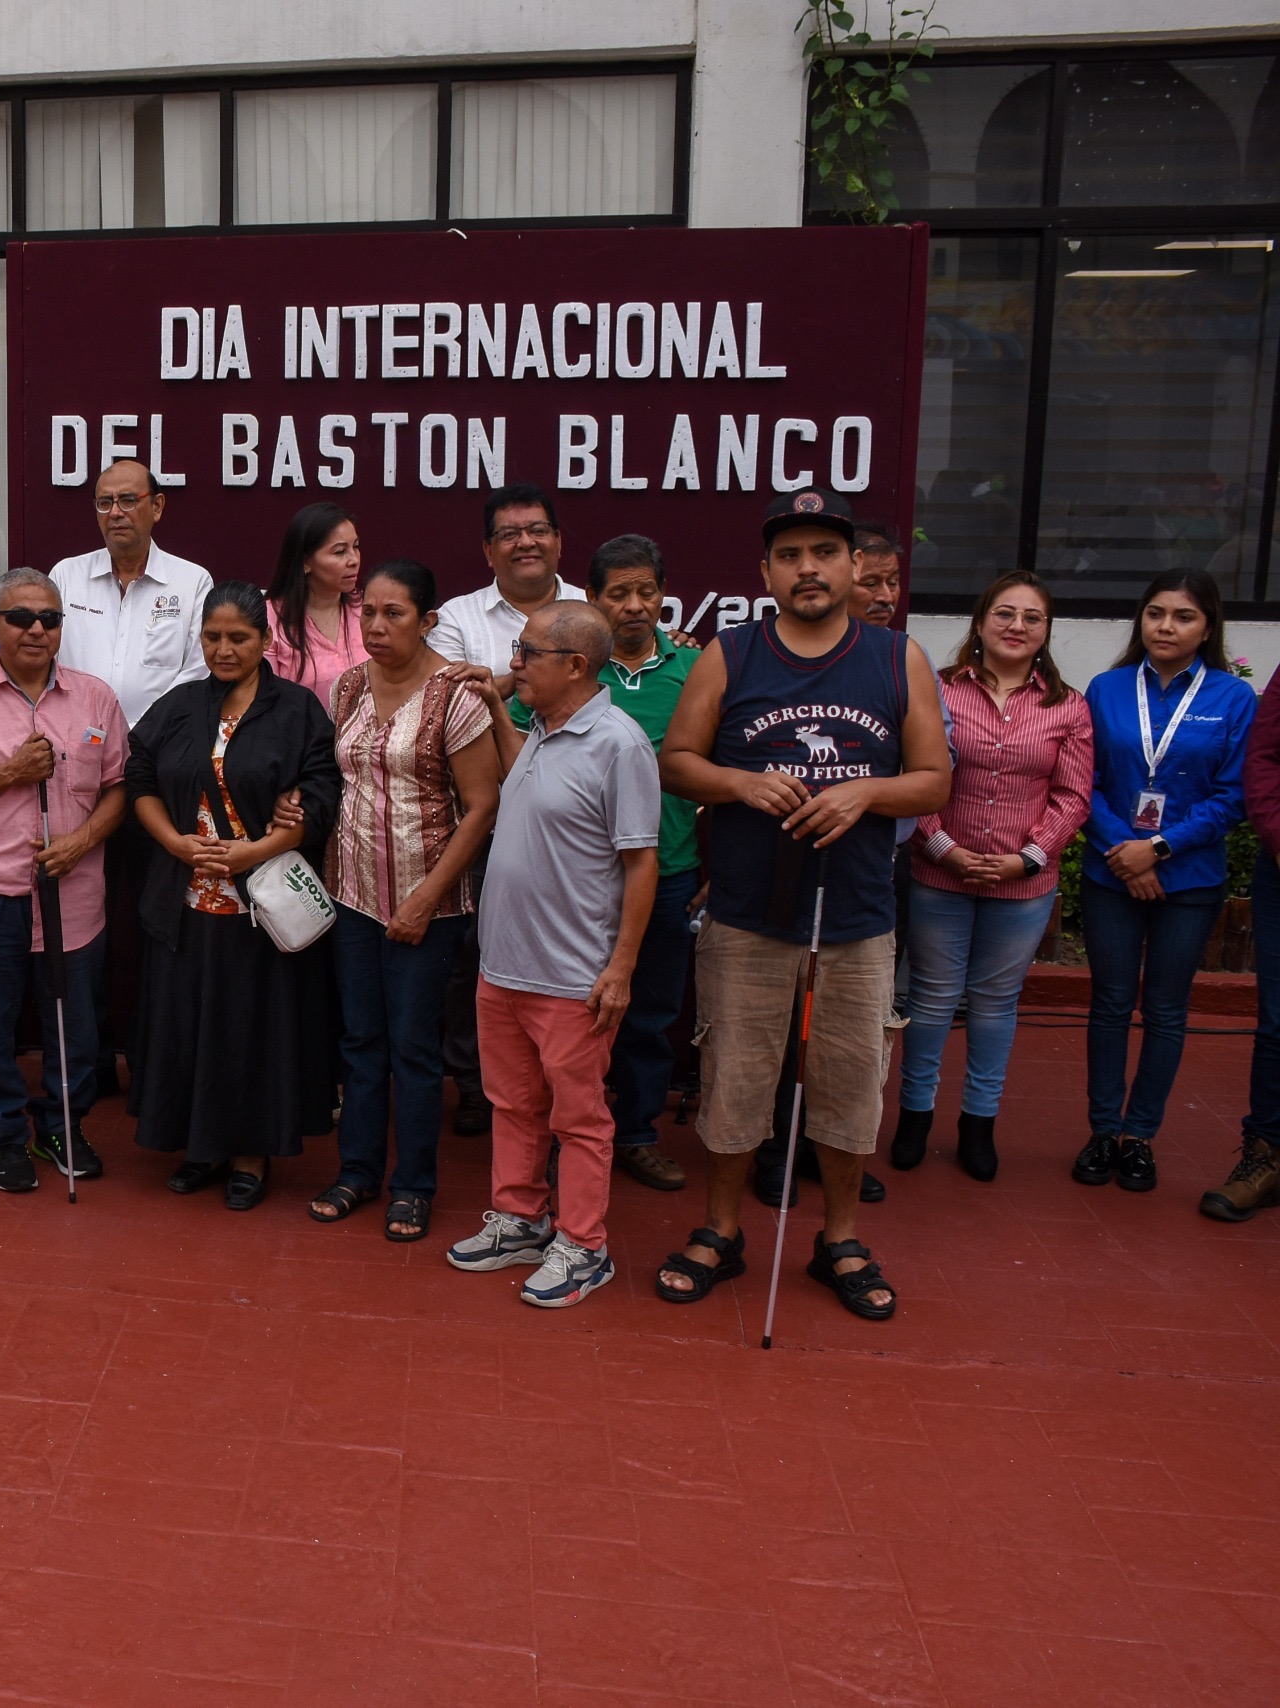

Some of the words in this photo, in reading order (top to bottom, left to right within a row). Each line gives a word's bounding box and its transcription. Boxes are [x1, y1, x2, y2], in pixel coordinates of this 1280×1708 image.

[160, 305, 252, 380] DIA
[284, 301, 787, 379] INTERNACIONAL
[51, 413, 186, 487] DEL
[222, 412, 506, 489] BASTON
[557, 413, 873, 493] BLANCO
[743, 705, 889, 741] ABERCROMBIE
[764, 763, 808, 778] AND
[813, 764, 871, 779] FITCH
[290, 863, 333, 917] LACOSTE
[299, 891, 324, 924] CLUB
